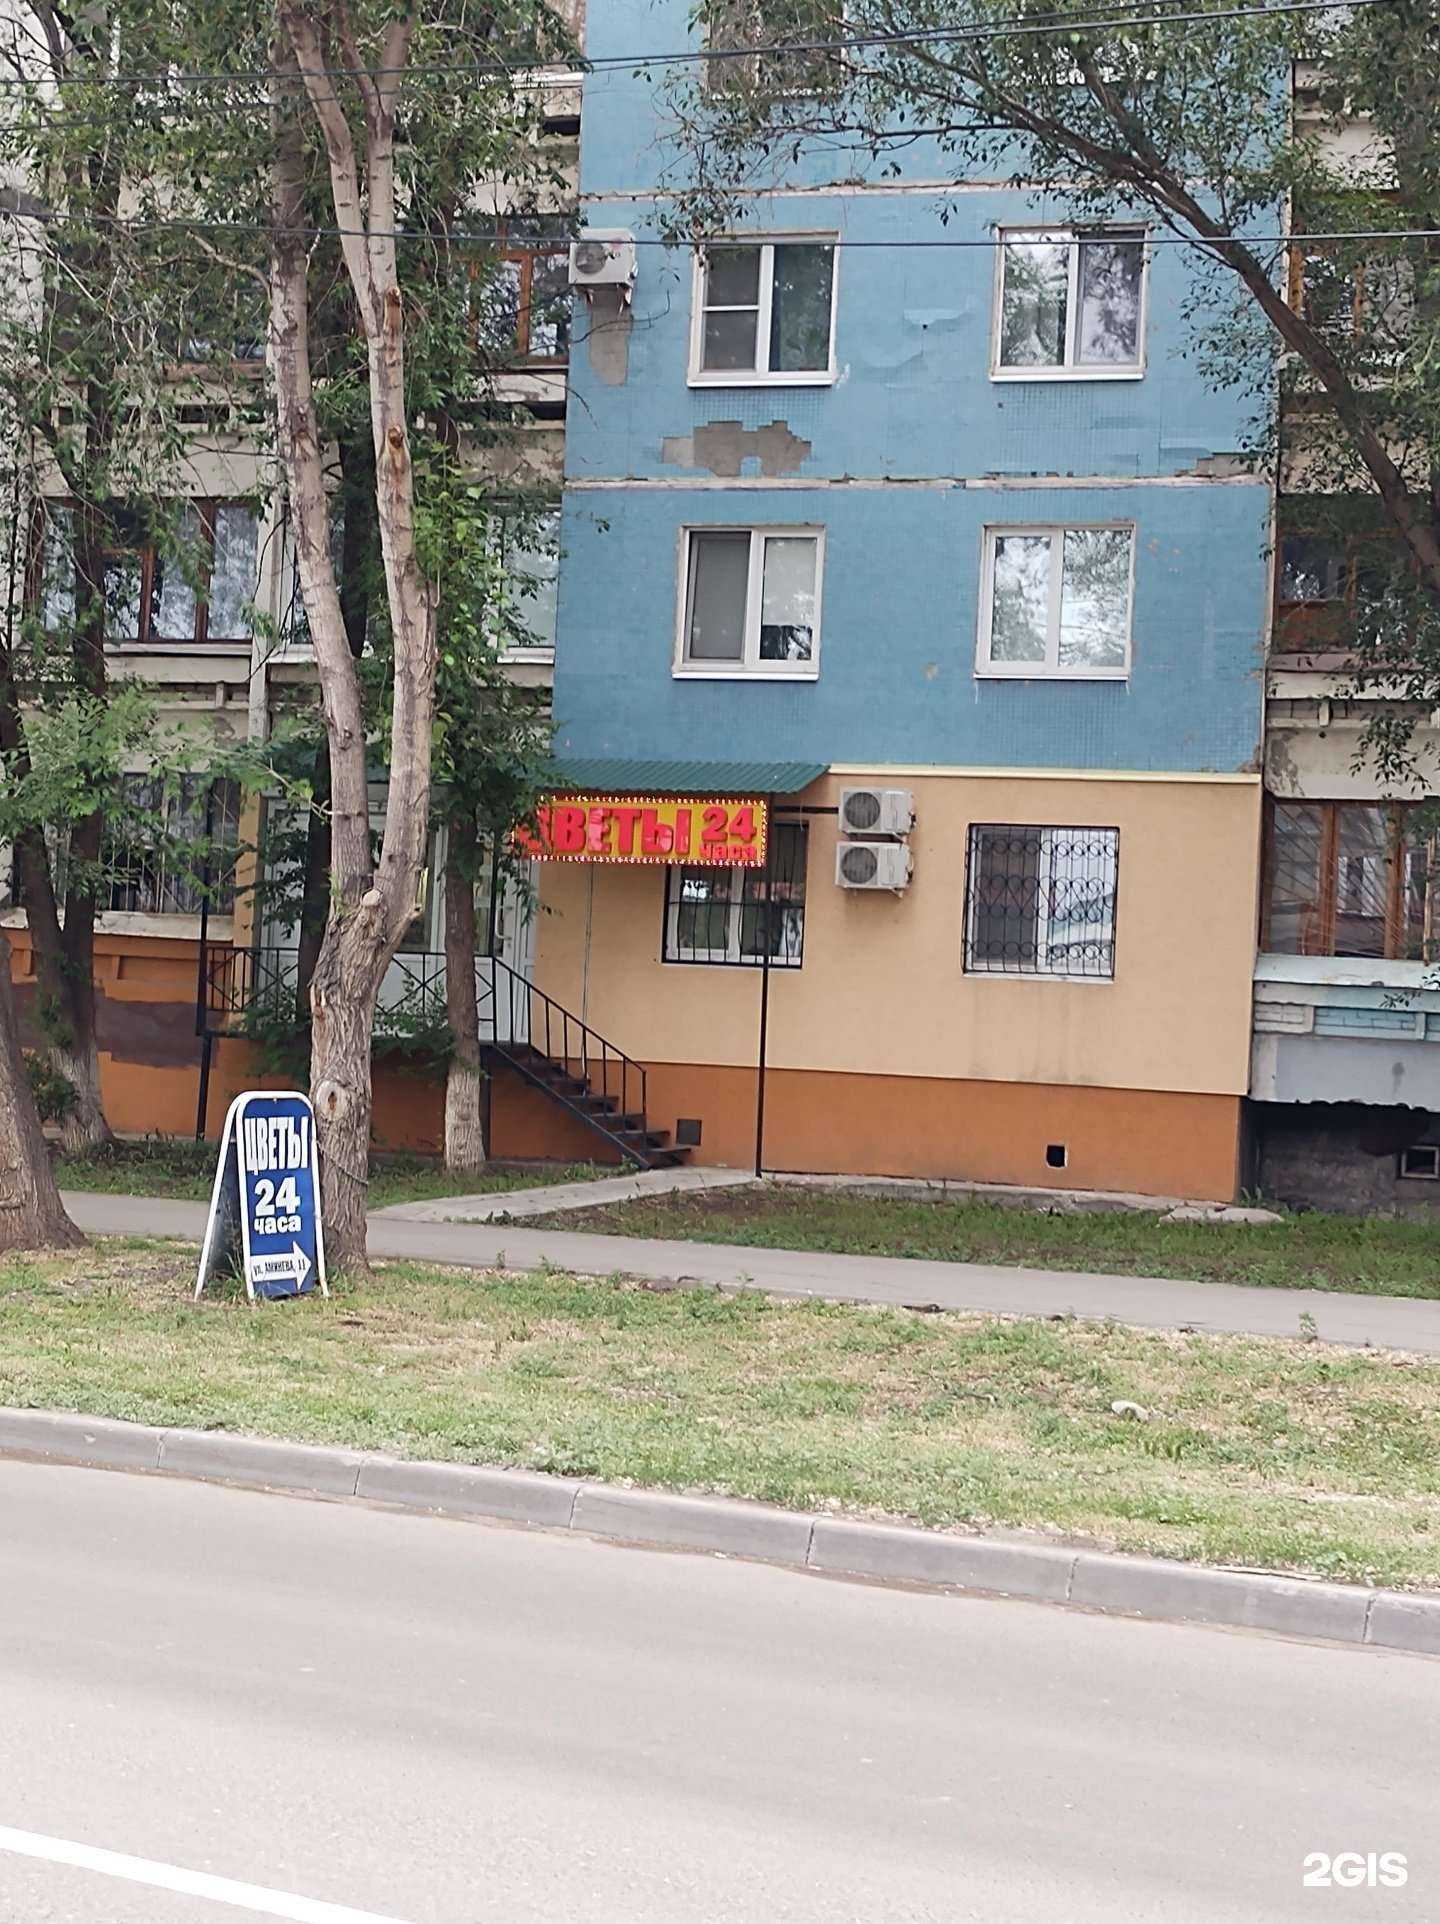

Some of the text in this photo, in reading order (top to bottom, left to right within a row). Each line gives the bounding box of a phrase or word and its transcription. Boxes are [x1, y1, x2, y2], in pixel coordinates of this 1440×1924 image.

[701, 806, 757, 842] 24
[245, 1117, 308, 1175] ЦВЕТЫ
[254, 1177, 300, 1216] 24
[254, 1215, 301, 1234] часа
